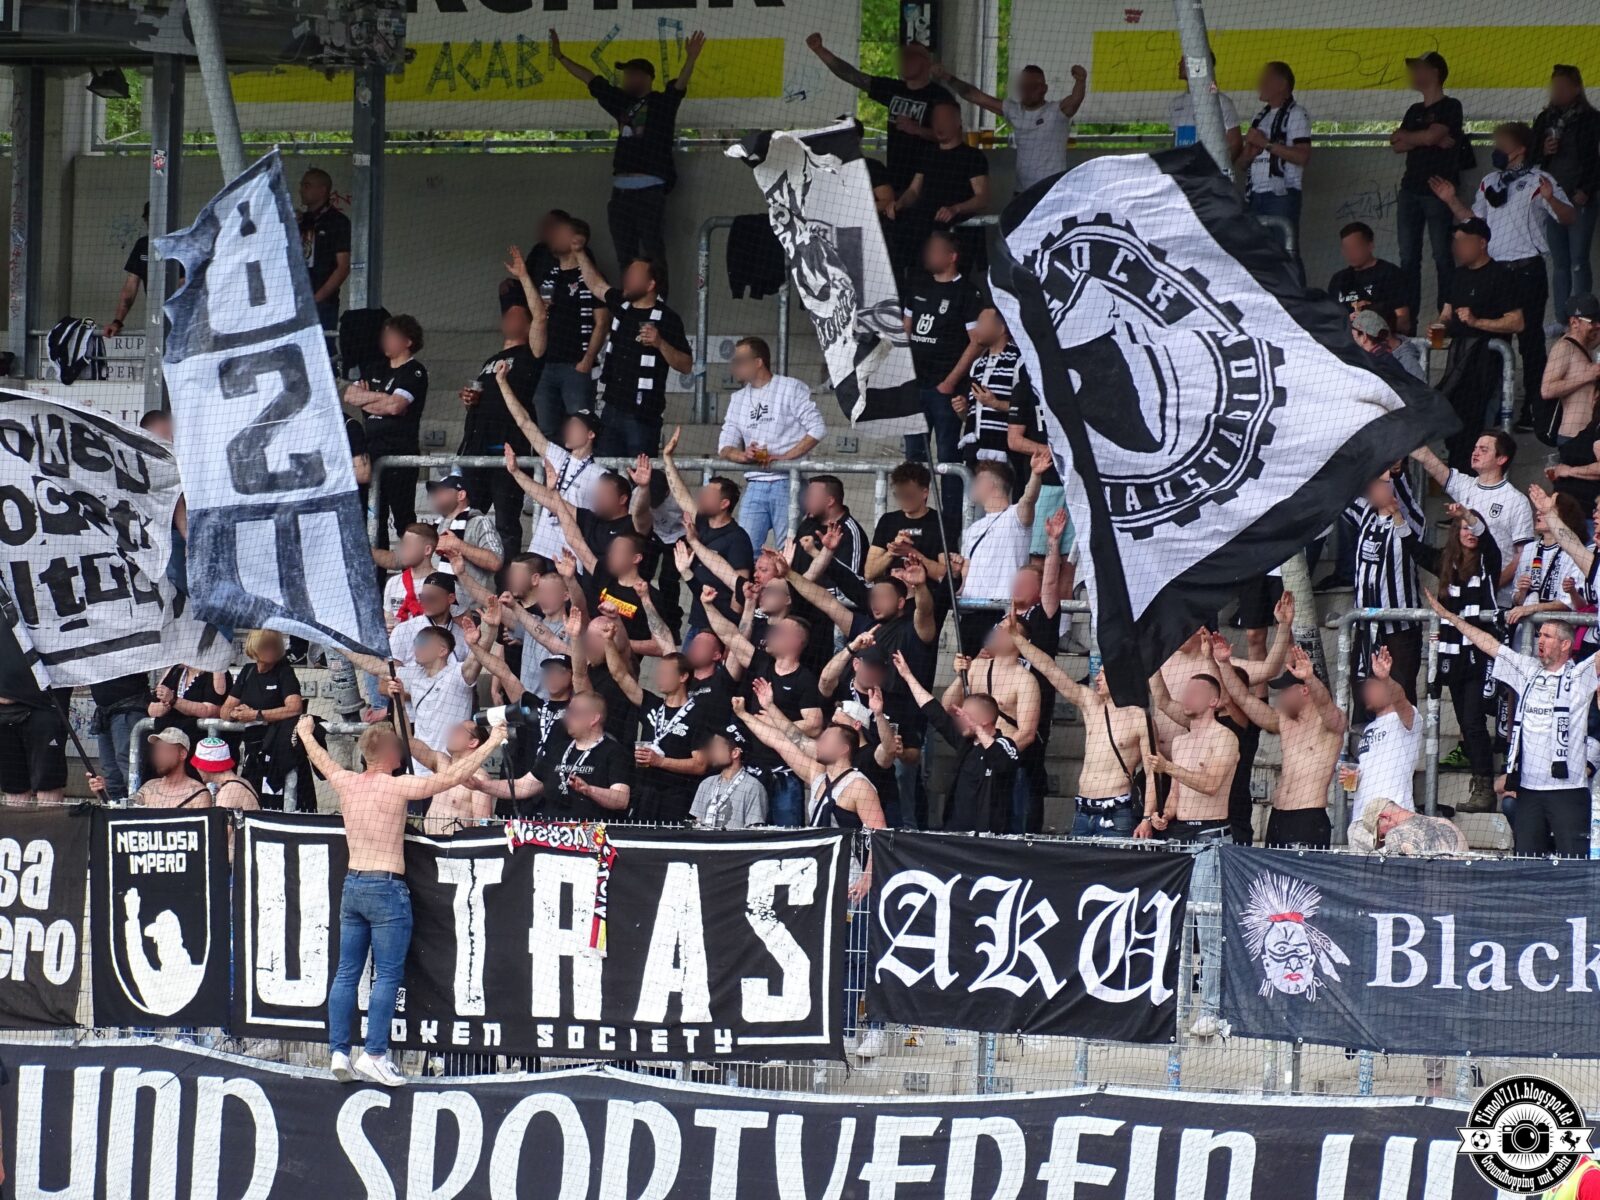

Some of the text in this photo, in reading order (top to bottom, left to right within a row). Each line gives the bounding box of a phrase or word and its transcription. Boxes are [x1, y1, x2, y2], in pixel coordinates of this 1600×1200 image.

[426, 34, 544, 95] ACAB
[117, 830, 198, 854] NEBULOSA
[129, 853, 187, 875] IMPERO
[255, 841, 818, 1023] UTRAS
[1366, 912, 1600, 993] Black
[361, 1016, 732, 1053] OKEN SOCIETY
